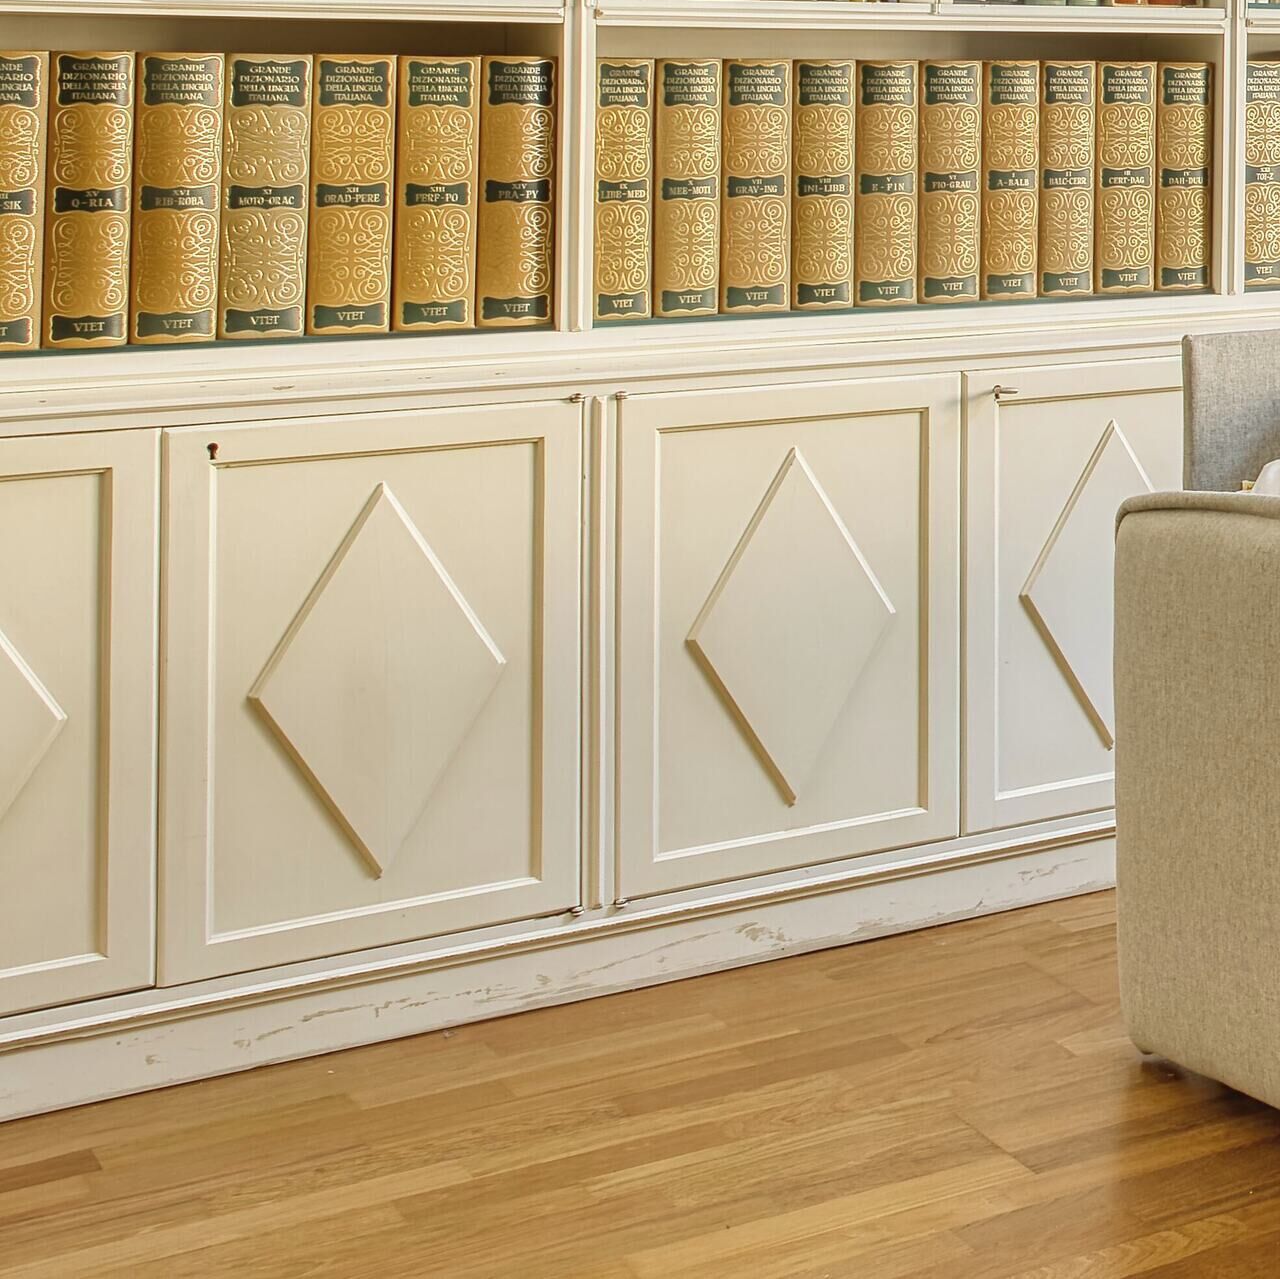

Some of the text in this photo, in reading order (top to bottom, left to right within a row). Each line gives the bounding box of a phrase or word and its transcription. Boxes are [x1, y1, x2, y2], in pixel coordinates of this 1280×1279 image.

[73, 63, 118, 71] GRANDE
[421, 67, 459, 75] GRANDE
[63, 73, 127, 81] DIZIONARIO
[674, 69, 708, 77] GRANDE
[412, 76, 468, 84] DIZIONARIO
[666, 77, 715, 85] DIZIONARIO
[63, 82, 127, 90] DELLA LINGUA
[73, 92, 117, 101] ITALIANA
